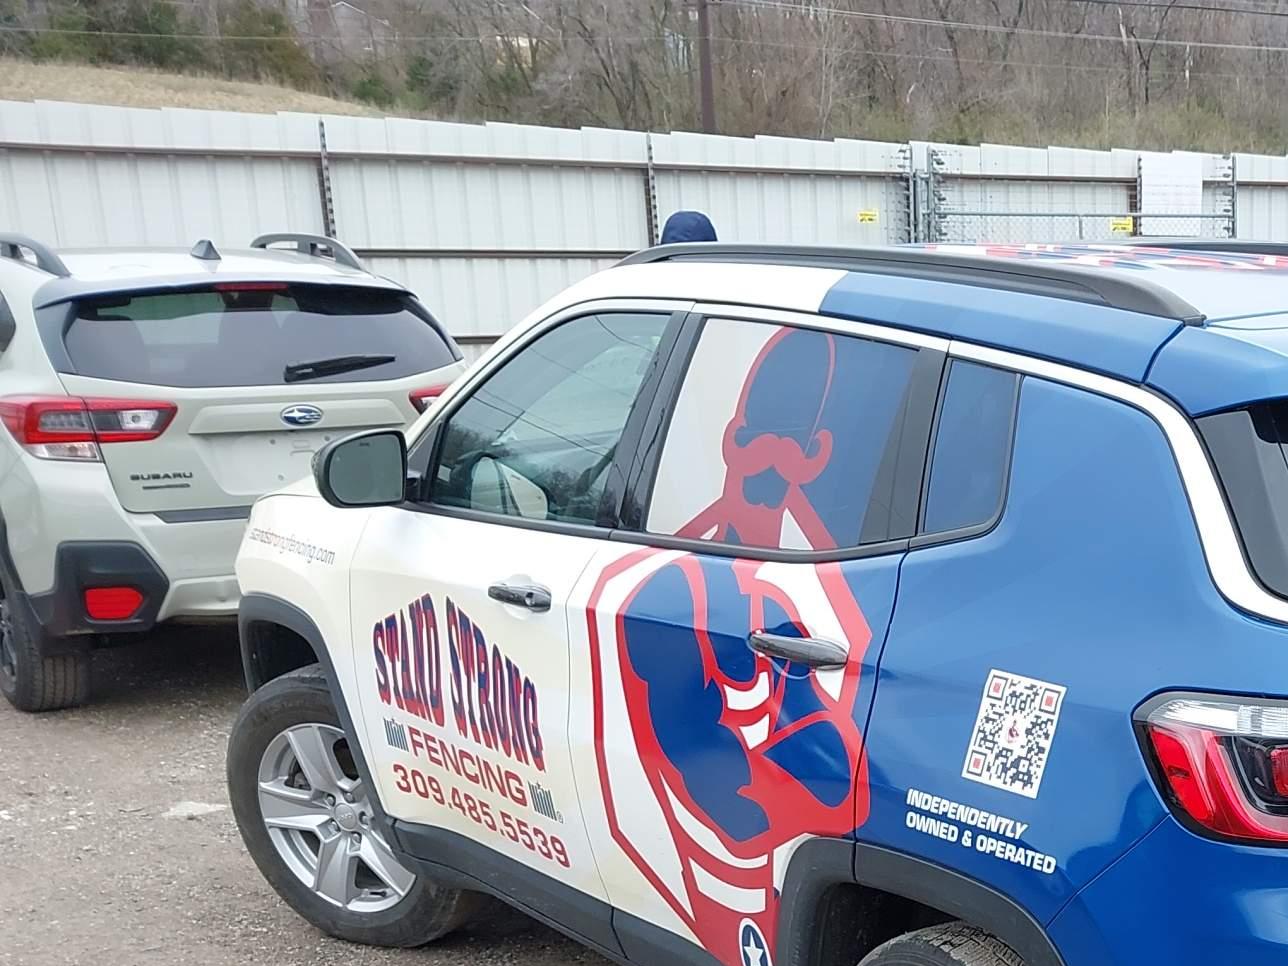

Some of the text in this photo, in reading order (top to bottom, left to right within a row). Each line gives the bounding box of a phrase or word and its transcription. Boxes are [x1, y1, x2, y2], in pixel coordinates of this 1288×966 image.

[373, 592, 546, 773] STAND STRONG
[408, 725, 528, 808] FENCING
[393, 763, 570, 868] 309.485.5539
[906, 788, 1028, 840] INDEPENDENTLY
[906, 811, 1057, 874] OWNED & OPERATED
